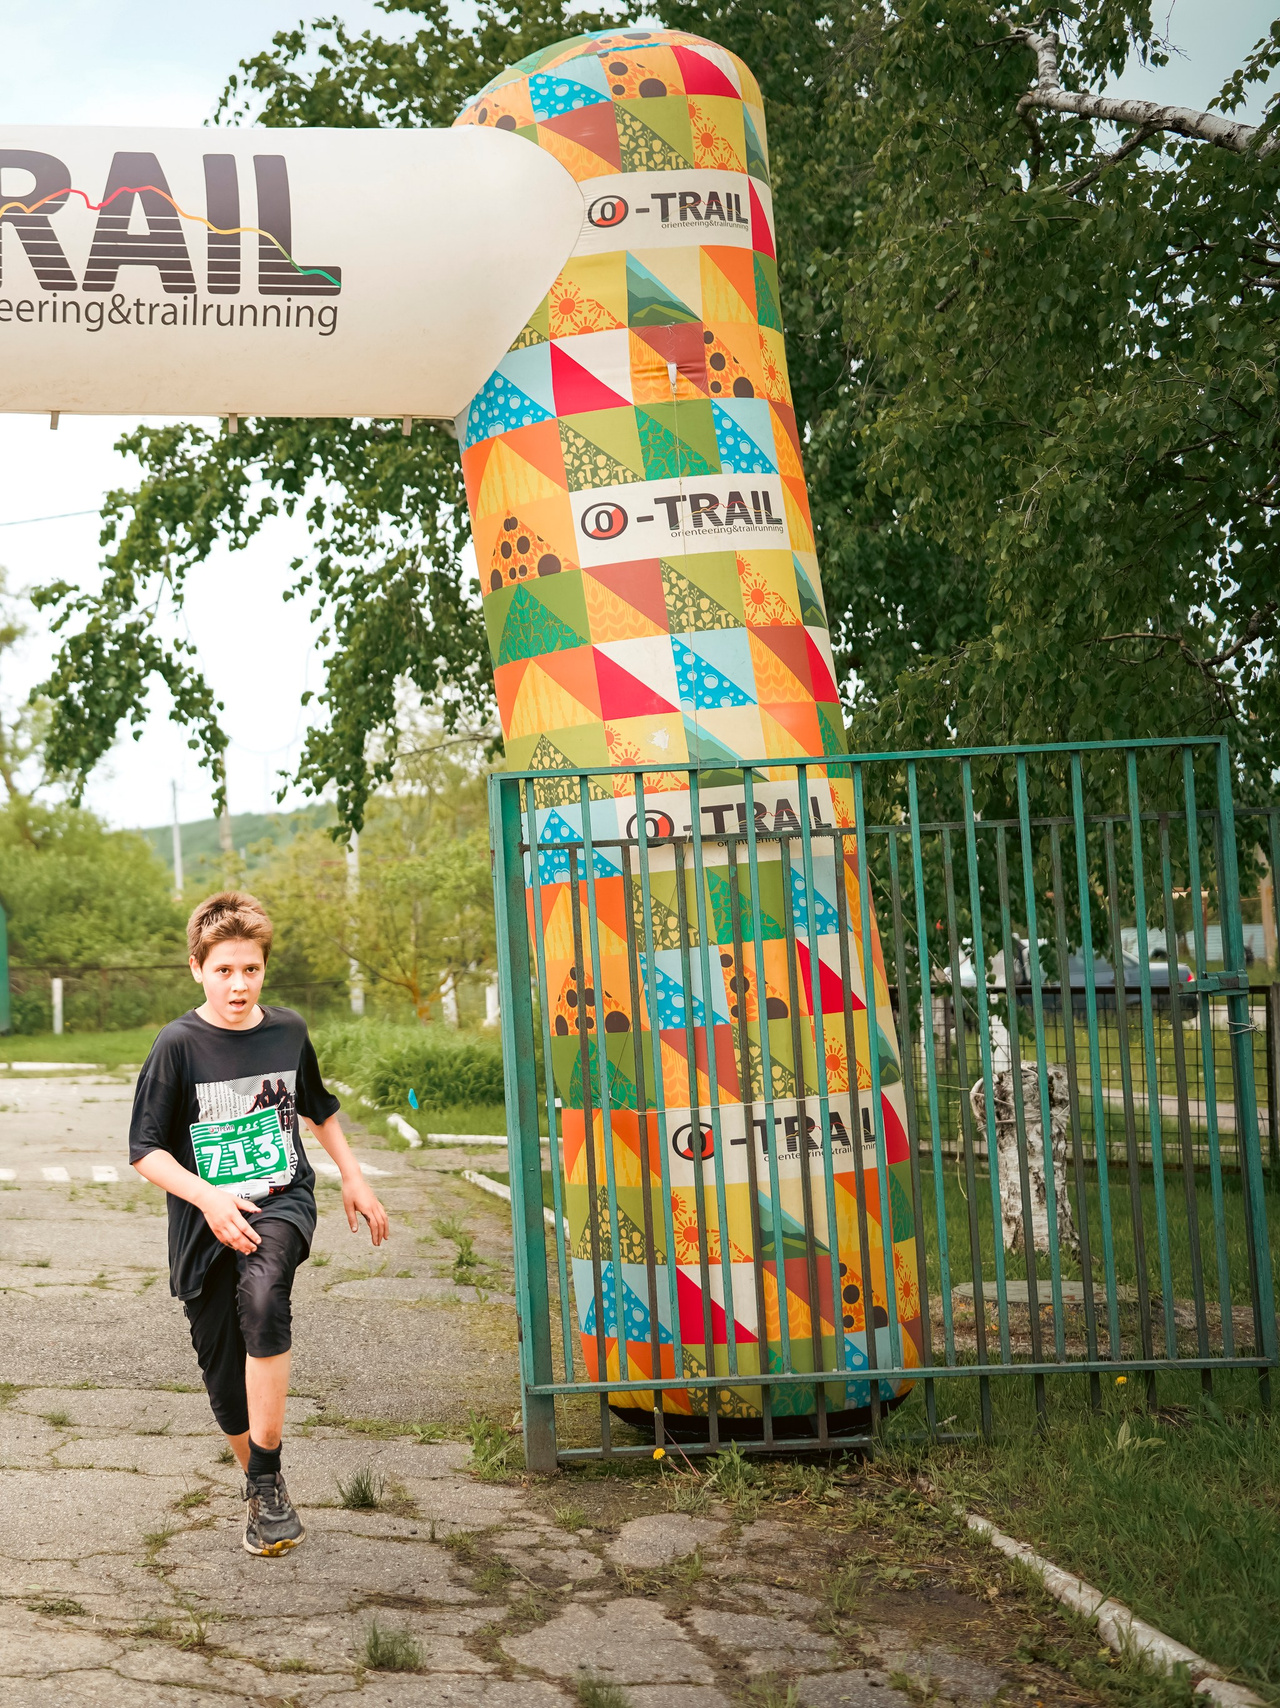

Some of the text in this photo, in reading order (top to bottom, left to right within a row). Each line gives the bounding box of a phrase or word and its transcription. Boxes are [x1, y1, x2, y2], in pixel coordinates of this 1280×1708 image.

[661, 219, 749, 231] orienteering&trailrunning
[670, 524, 784, 538] orienteering&trailrunning
[200, 1132, 280, 1179] 713
